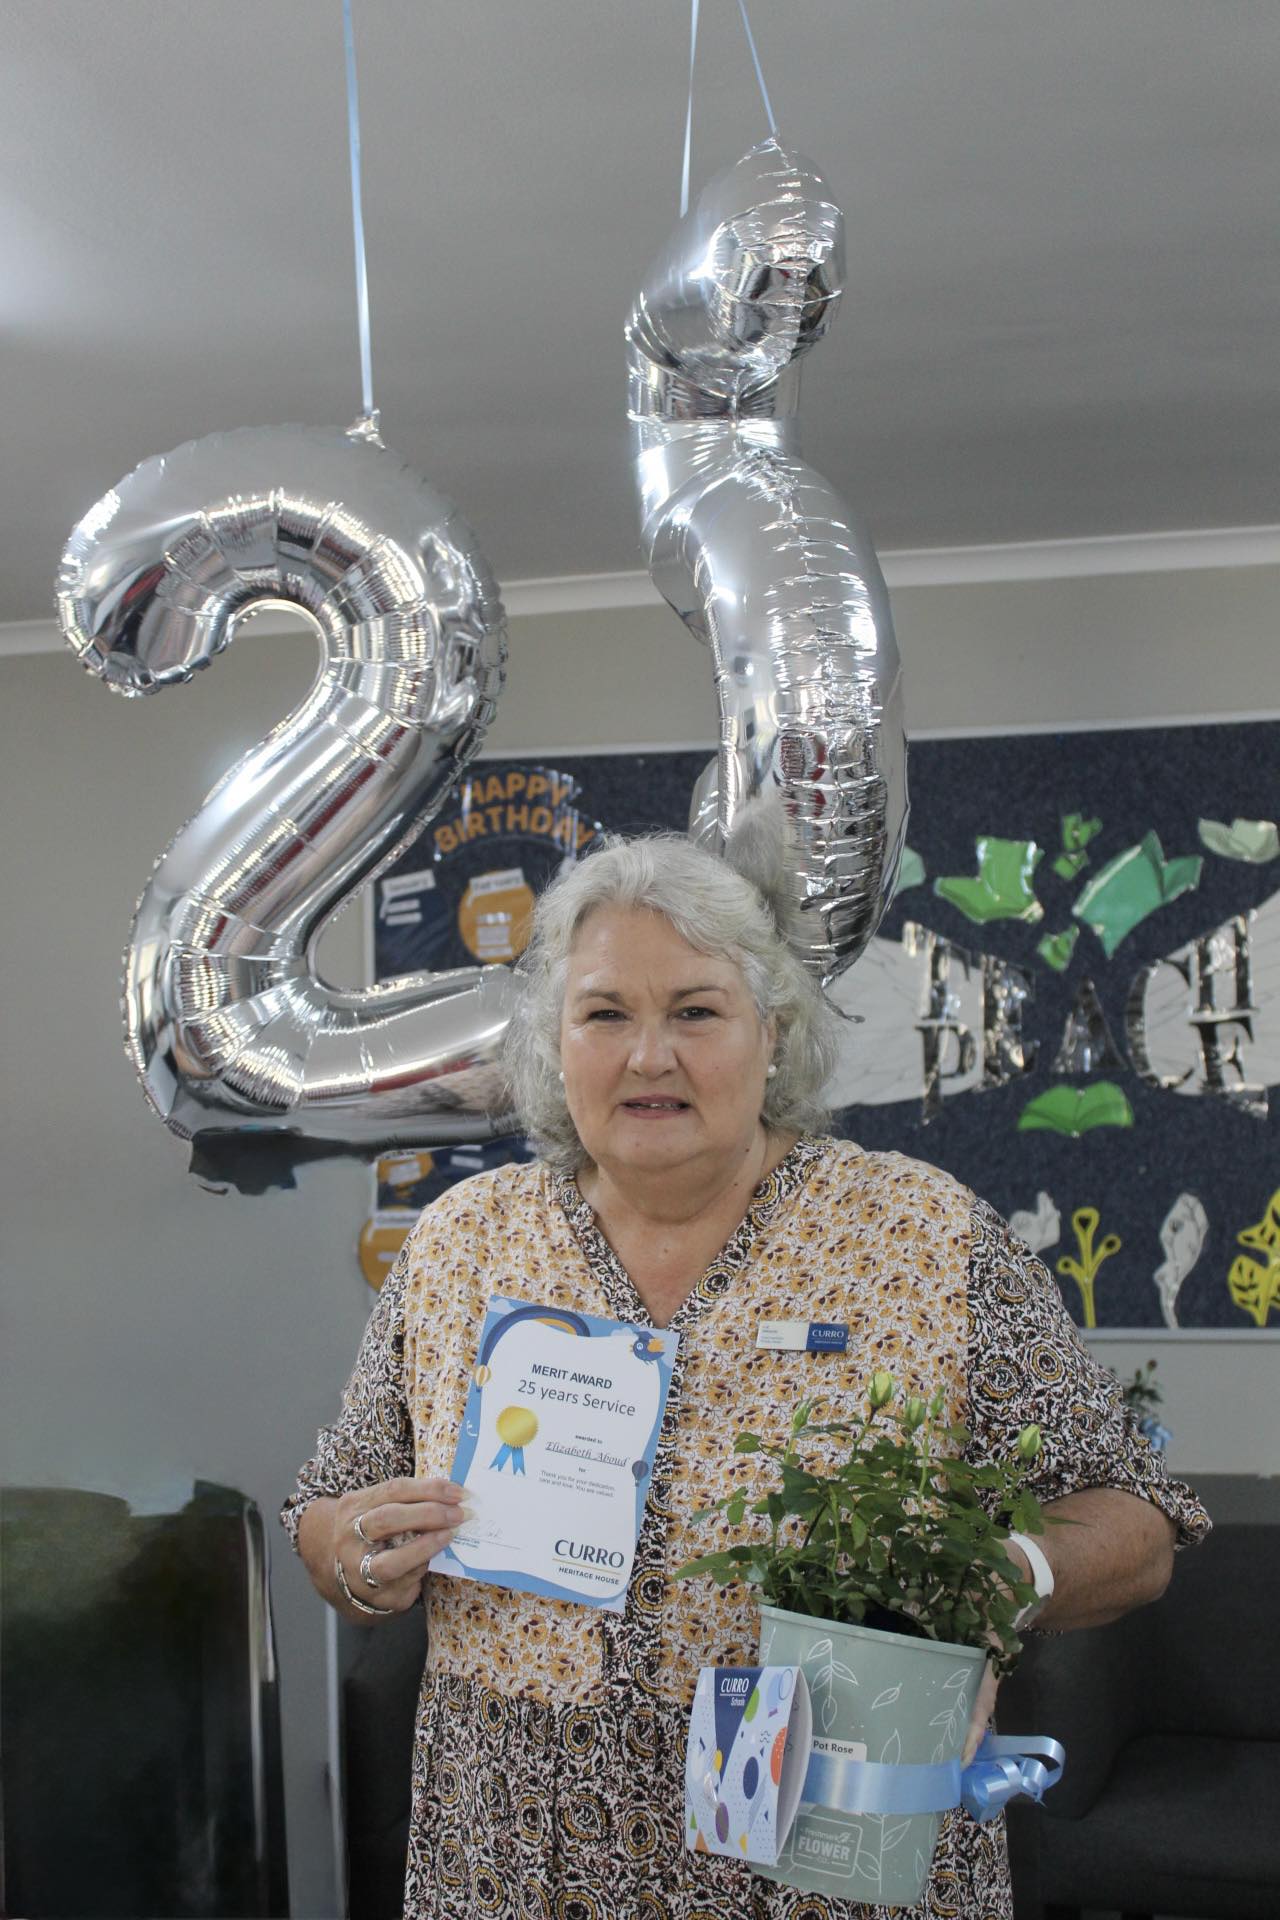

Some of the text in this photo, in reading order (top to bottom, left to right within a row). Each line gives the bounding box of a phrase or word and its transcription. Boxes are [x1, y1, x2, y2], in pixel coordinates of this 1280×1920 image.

[460, 772, 570, 806] HAPPY
[433, 804, 596, 853] BIRTHDAY
[812, 1329, 845, 1338] CURRO
[531, 1364, 613, 1389] MERIT AWARD
[518, 1379, 636, 1417] 25 years Service
[555, 1539, 625, 1568] CURRO
[559, 1566, 620, 1586] HERITAGE HOUSE
[720, 1677, 750, 1693] CURRO
[813, 1739, 854, 1755] Pot Rose
[799, 1835, 850, 1861] FLOWER
